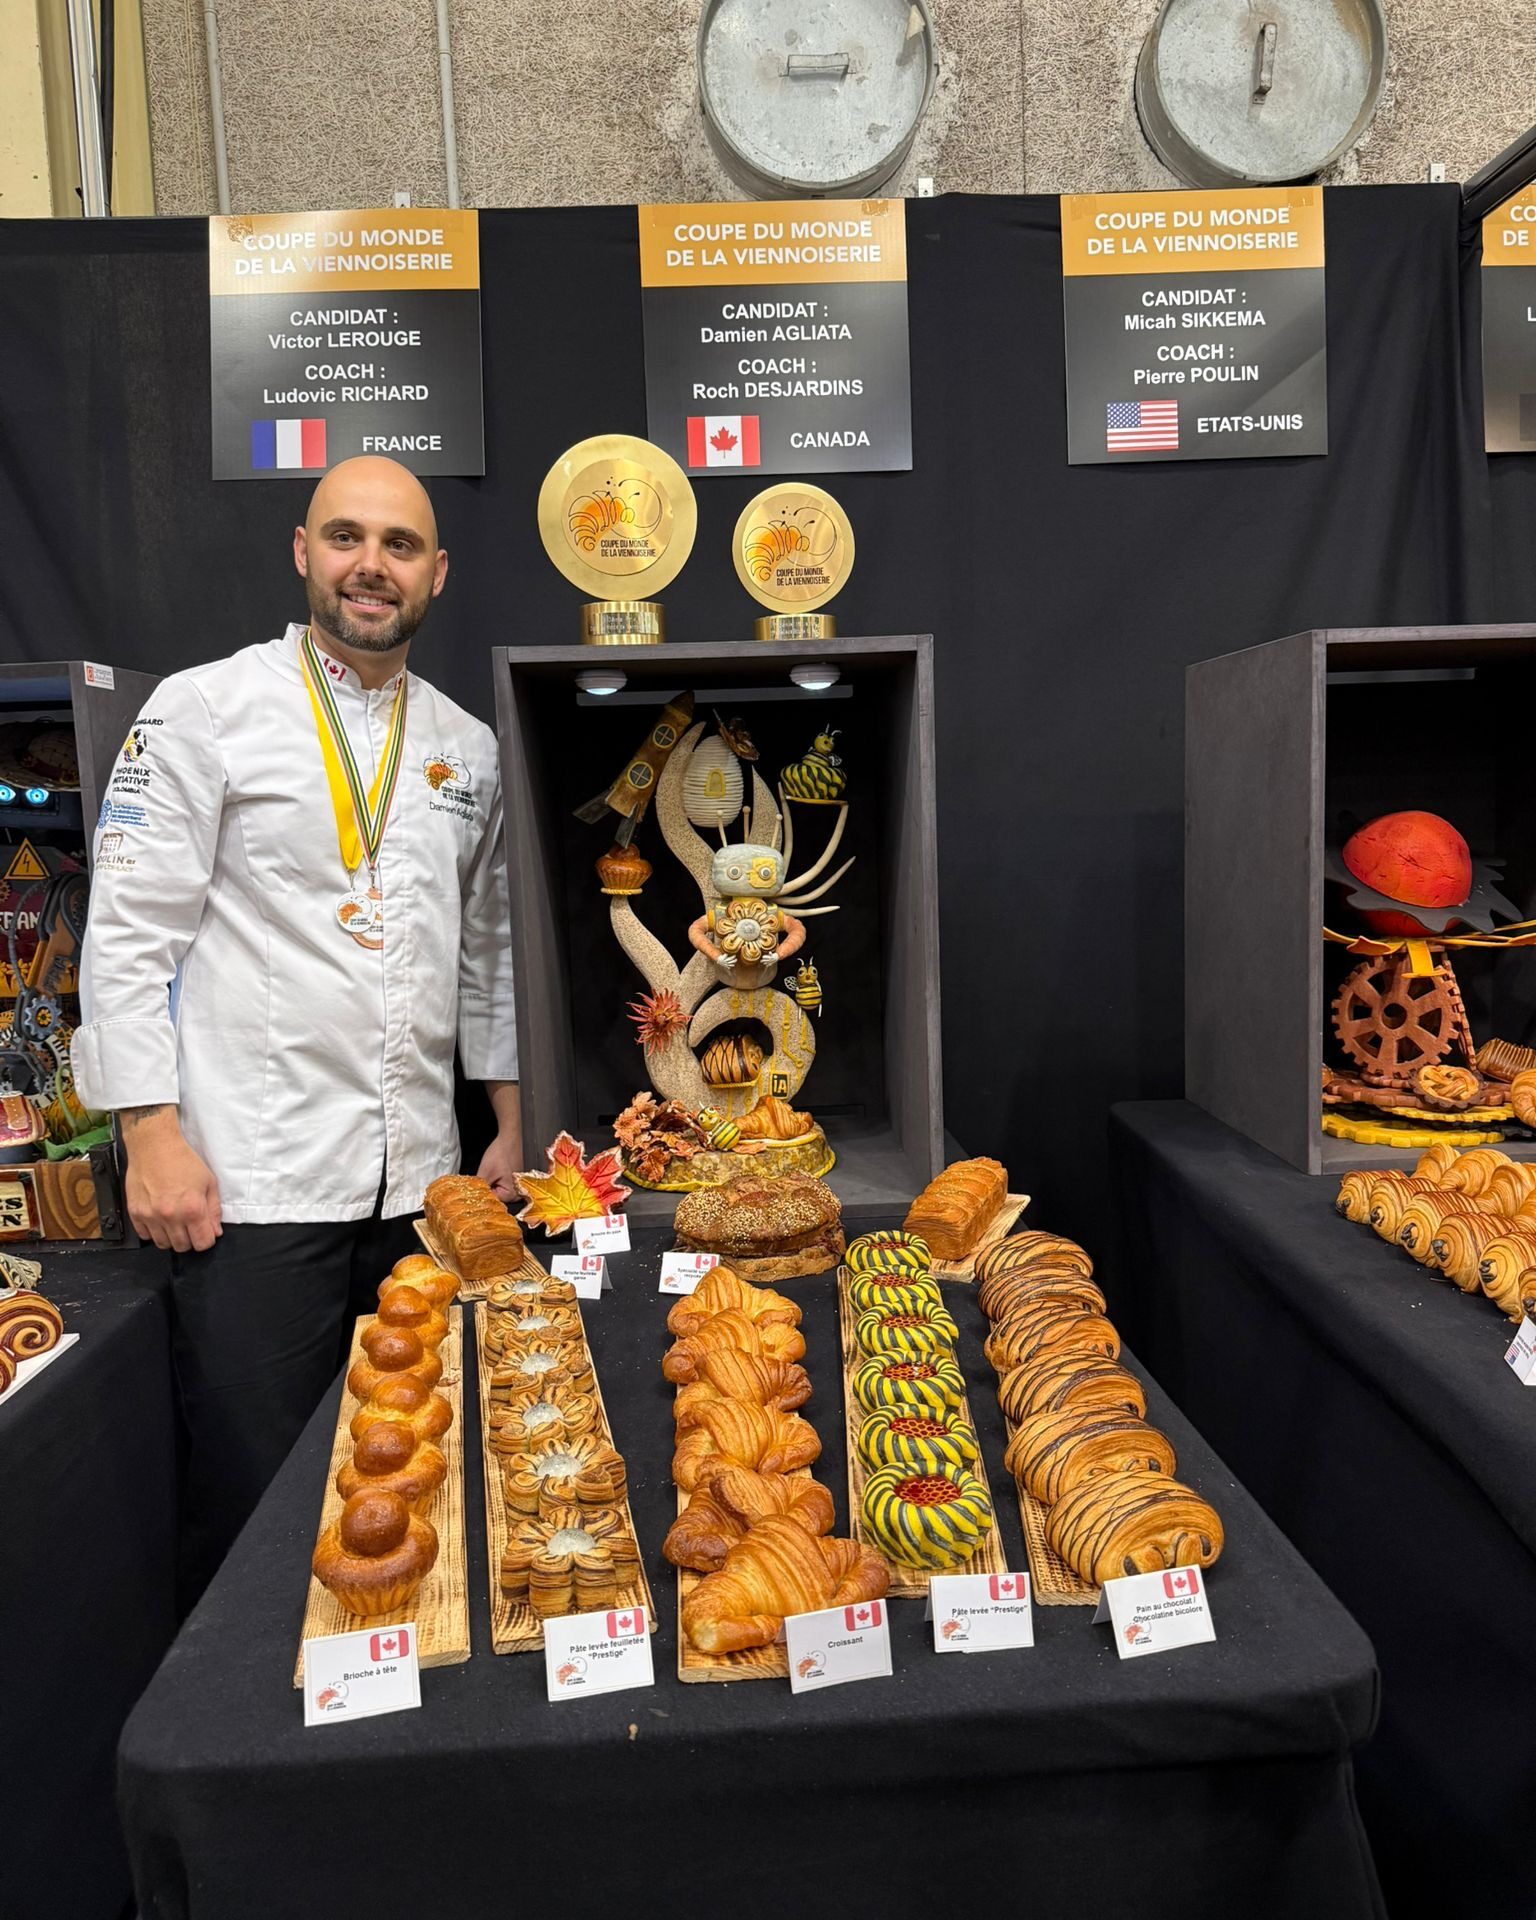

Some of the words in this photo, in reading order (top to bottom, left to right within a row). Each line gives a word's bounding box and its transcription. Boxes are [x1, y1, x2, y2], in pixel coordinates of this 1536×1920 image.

[1095, 212, 1166, 230] COUPE
[1173, 211, 1202, 228] DU
[1210, 207, 1289, 226] MONDE
[674, 224, 746, 241] COUPE
[754, 223, 783, 239] DU
[791, 221, 872, 238] MONDE
[1503, 229, 1529, 246] DE
[244, 232, 316, 251] COUPE
[324, 231, 353, 248] DU
[361, 229, 443, 246] MONDE
[1087, 238, 1114, 255] DE
[1122, 237, 1147, 253] LA
[1153, 232, 1298, 252] VIENNOISERIE
[235, 259, 263, 275] DE
[270, 257, 296, 274] LA
[303, 254, 453, 272] VIENNOISERIE
[666, 251, 694, 267] DE
[701, 249, 727, 265] LA
[734, 245, 881, 264] VIENNOISERIE
[1142, 289, 1235, 306] CANDIDAT
[290, 309, 387, 326] CANDIDAT
[722, 303, 817, 319] CANDIDAT
[1125, 314, 1176, 330] Micah
[1182, 311, 1266, 328] SIKKEMA
[269, 334, 322, 349] Victor
[328, 331, 421, 347] LEROUGE
[701, 326, 767, 343] Damien
[773, 325, 852, 340] AGLIATA
[1157, 345, 1223, 361] COACH
[305, 364, 374, 380] COACH
[738, 359, 805, 374] COACH
[1134, 369, 1185, 384] Pierre
[1191, 366, 1258, 382] POULIN
[264, 389, 336, 403] Ludovic
[342, 386, 429, 401] RICHARD
[693, 383, 739, 399] Roch
[745, 380, 863, 397] DESJARDINS
[1197, 414, 1303, 433] ETATS-UNIS
[363, 436, 441, 451] FRANCE
[790, 431, 870, 448] CANADA
[600, 540, 619, 548] COUPE
[620, 540, 628, 548] DU
[629, 540, 649, 548] MONDE
[600, 549, 609, 557] DE
[610, 549, 617, 557] LA
[618, 549, 656, 557] VIENNOISERIE
[776, 568, 794, 577] COUPE
[795, 568, 803, 576] DU
[776, 578, 784, 586] DE
[785, 578, 792, 586] LA
[793, 576, 830, 585] VIENNOISERIE
[952, 1608, 968, 1616] Pâte
[970, 1607, 988, 1615] levée
[1163, 1598, 1192, 1608] chocolat
[1133, 1611, 1173, 1623] Chocolatine
[1175, 1606, 1203, 1616] bicolore
[570, 1644, 587, 1653] Pâte
[588, 1642, 609, 1651] levée
[610, 1637, 644, 1648] feuilletée
[828, 1636, 863, 1648] Croissant
[343, 1670, 374, 1681] Brioche
[382, 1666, 398, 1674] tête
